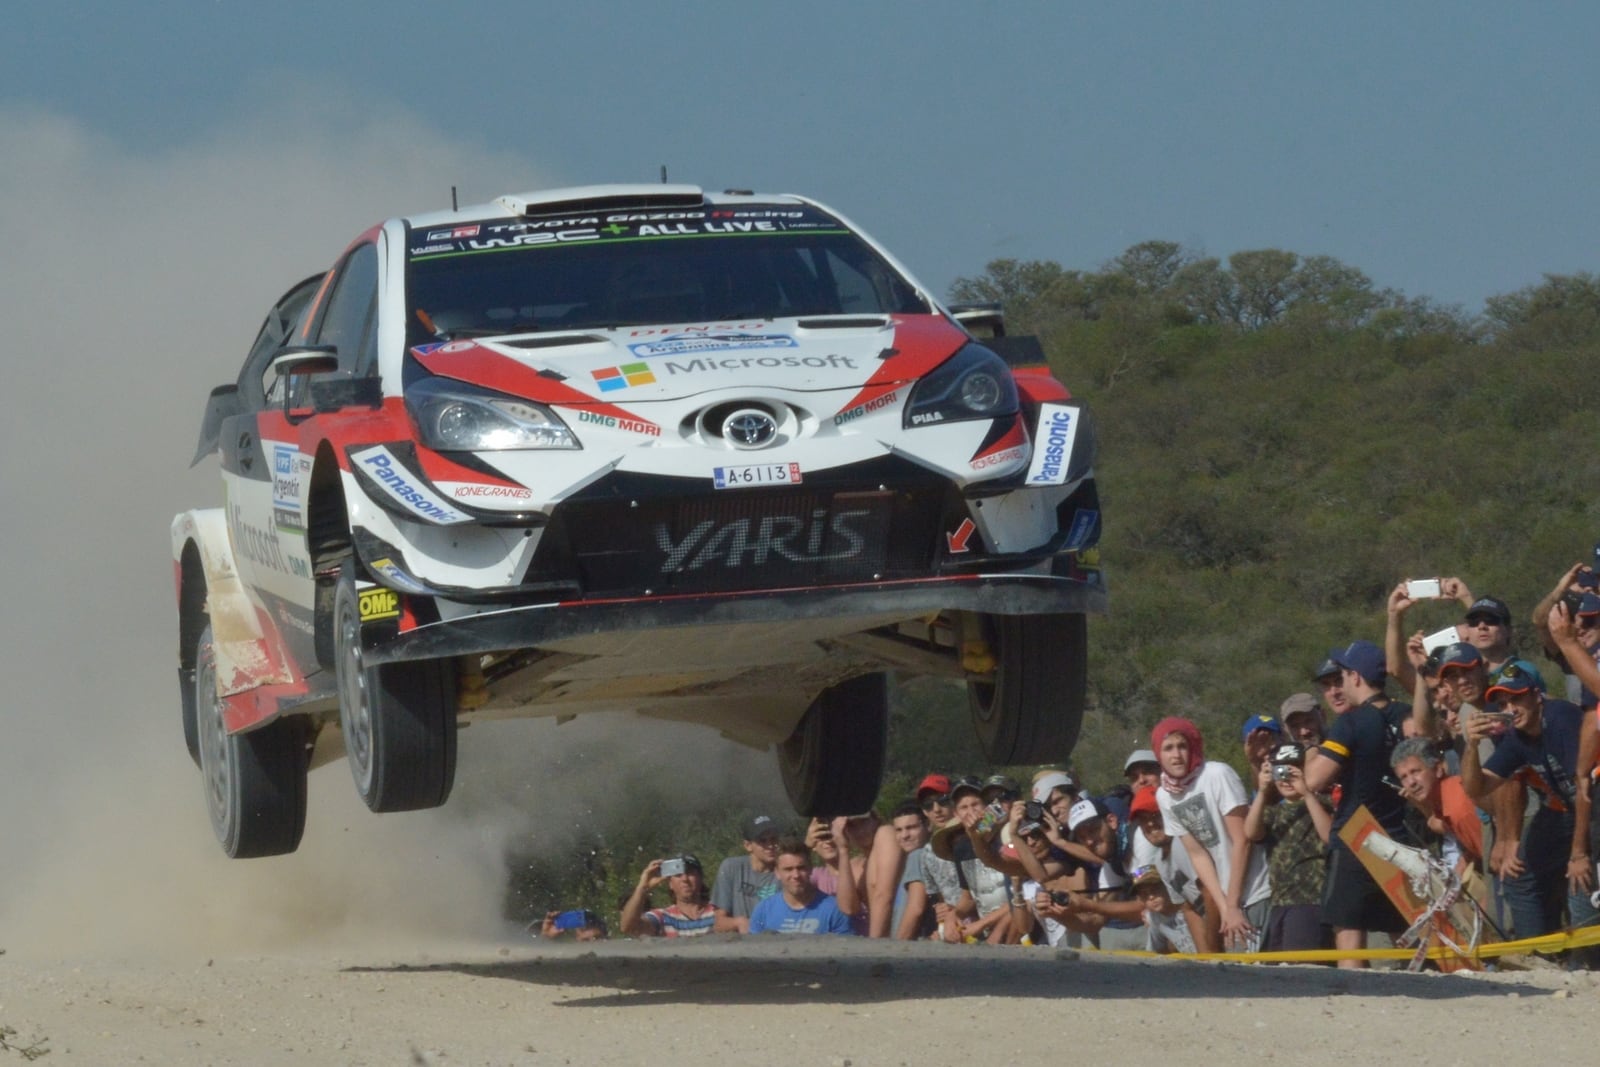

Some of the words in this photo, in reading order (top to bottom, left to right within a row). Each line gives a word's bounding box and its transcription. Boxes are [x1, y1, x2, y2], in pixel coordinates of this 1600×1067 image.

[487, 217, 598, 233] TOYOTA
[606, 211, 706, 223] GAZOO
[711, 210, 804, 220] Racing
[469, 229, 600, 250] WRC
[638, 222, 699, 236] ALL
[704, 220, 777, 233] LIVE
[630, 323, 765, 337] DENSO
[664, 353, 859, 376] Microsoft
[833, 407, 864, 426] DMG
[864, 392, 898, 413] MORI
[911, 411, 945, 425] PIAA
[578, 411, 616, 429] DMG
[618, 420, 662, 437] MORI
[1032, 410, 1071, 483] Panasonic
[364, 452, 457, 523] Panasonic
[454, 486, 533, 500] KONECRANES
[359, 591, 400, 616] OMP
